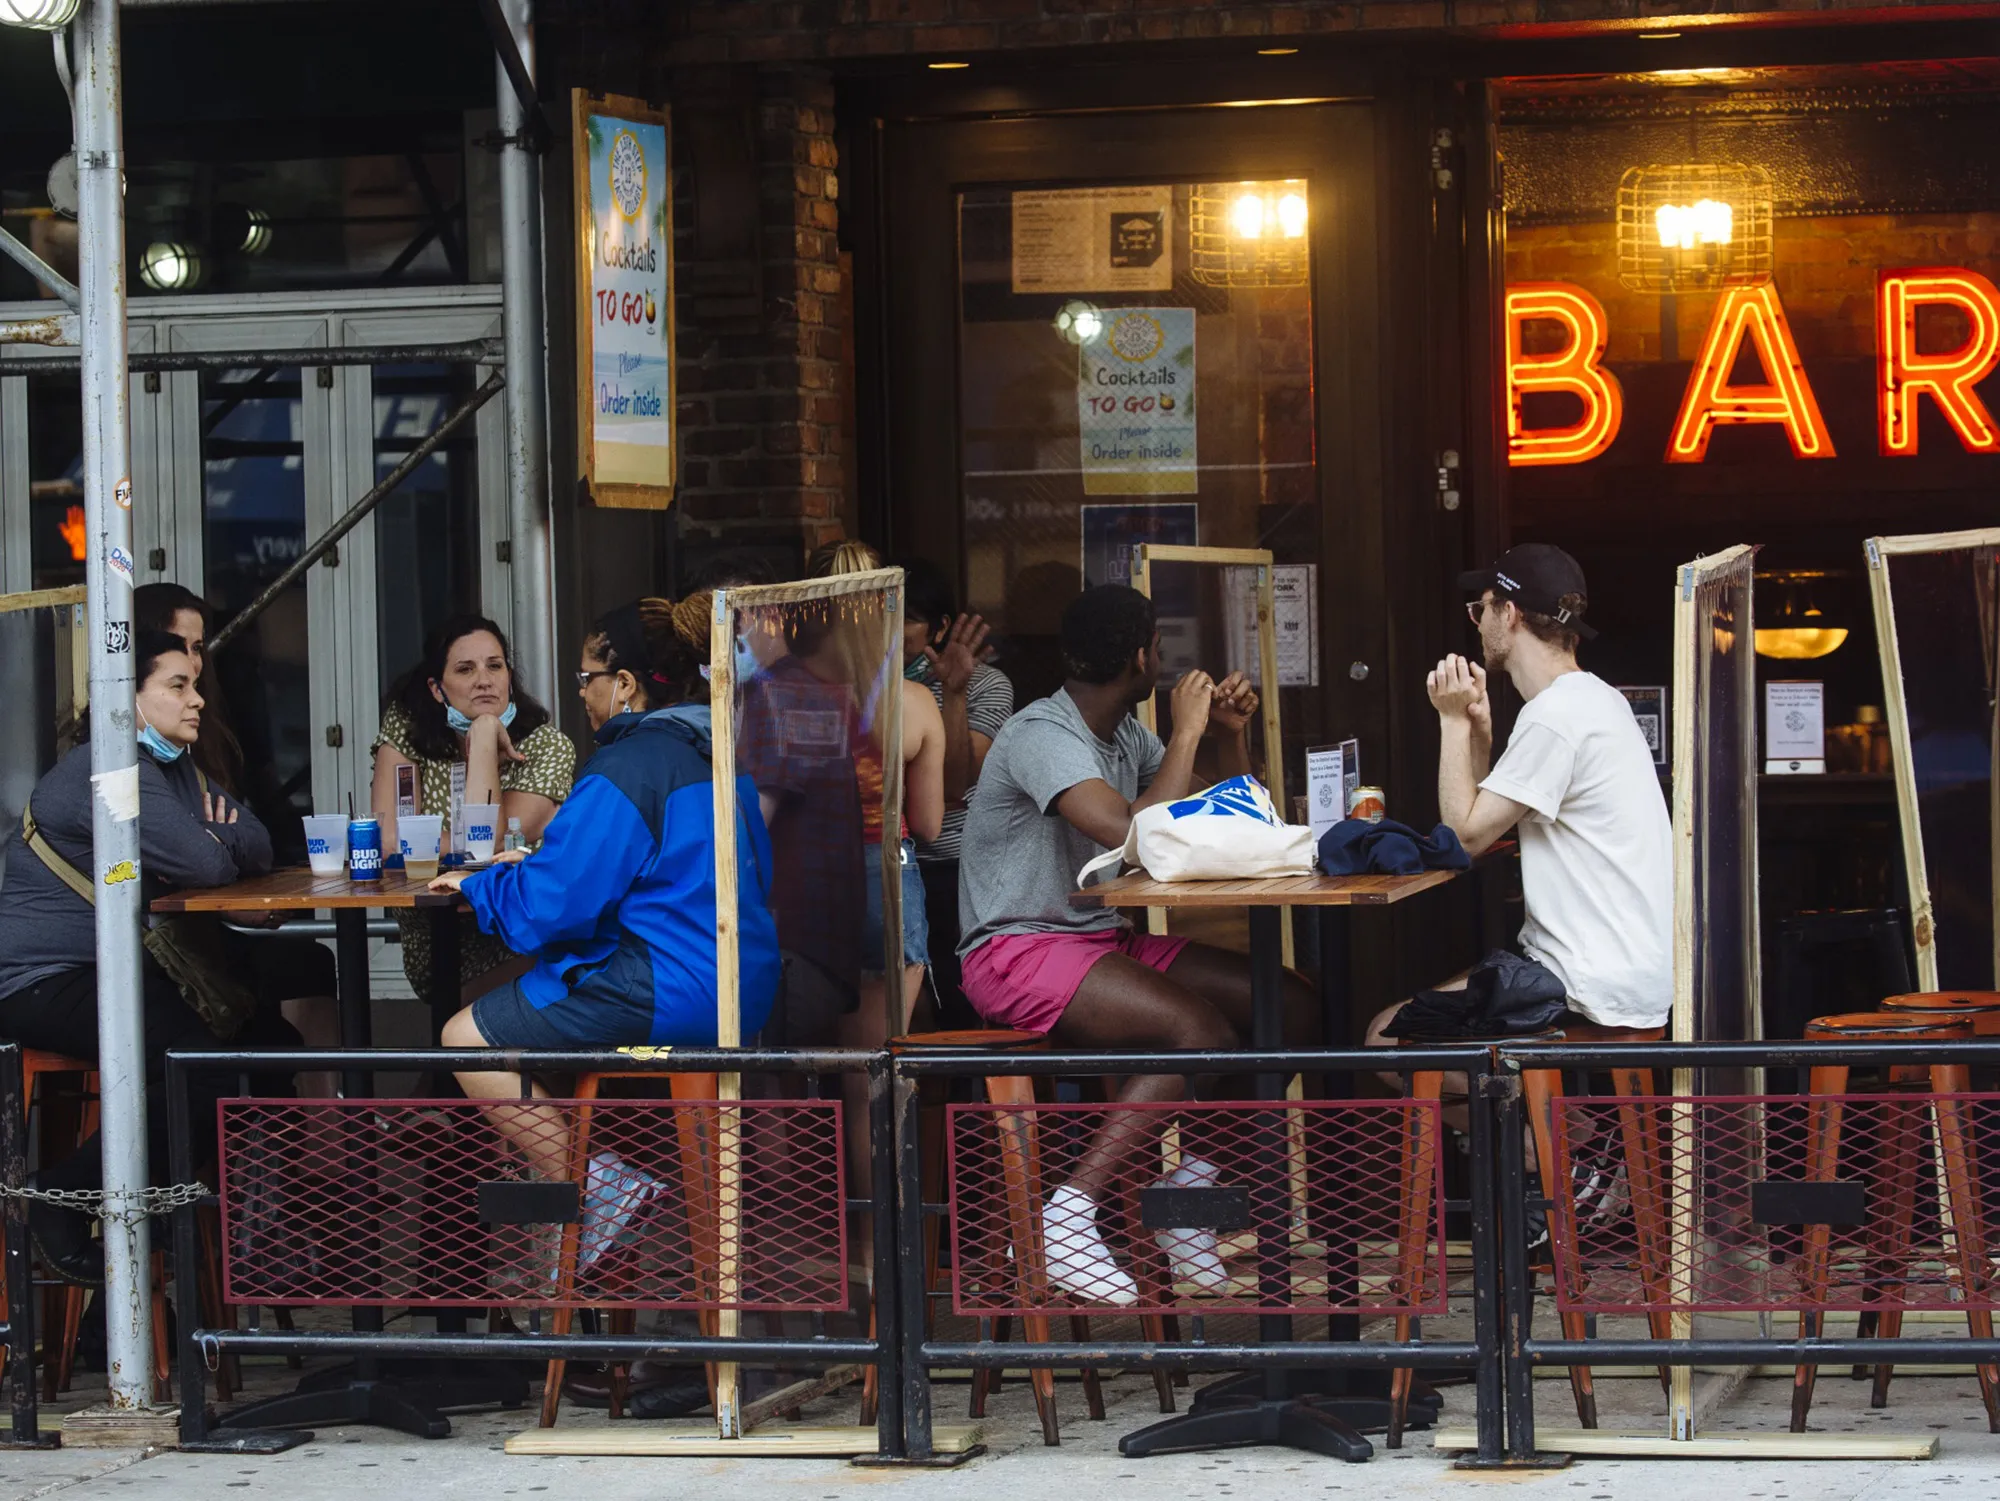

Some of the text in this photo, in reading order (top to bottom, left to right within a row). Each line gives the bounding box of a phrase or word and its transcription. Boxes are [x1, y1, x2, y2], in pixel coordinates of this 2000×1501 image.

[602, 231, 656, 274] Cocktails
[597, 289, 643, 327] TO GO
[618, 350, 642, 378] Please
[1504, 266, 2000, 467] BAR
[1096, 366, 1177, 386] Cocktails
[600, 382, 661, 417] Order inside
[1088, 396, 1156, 416] TO GO
[1091, 442, 1182, 460] Order inside
[467, 832, 494, 841] LIGHT
[470, 825, 492, 834] BUD
[350, 859, 382, 870] LIGHT
[352, 849, 379, 860] BUD
